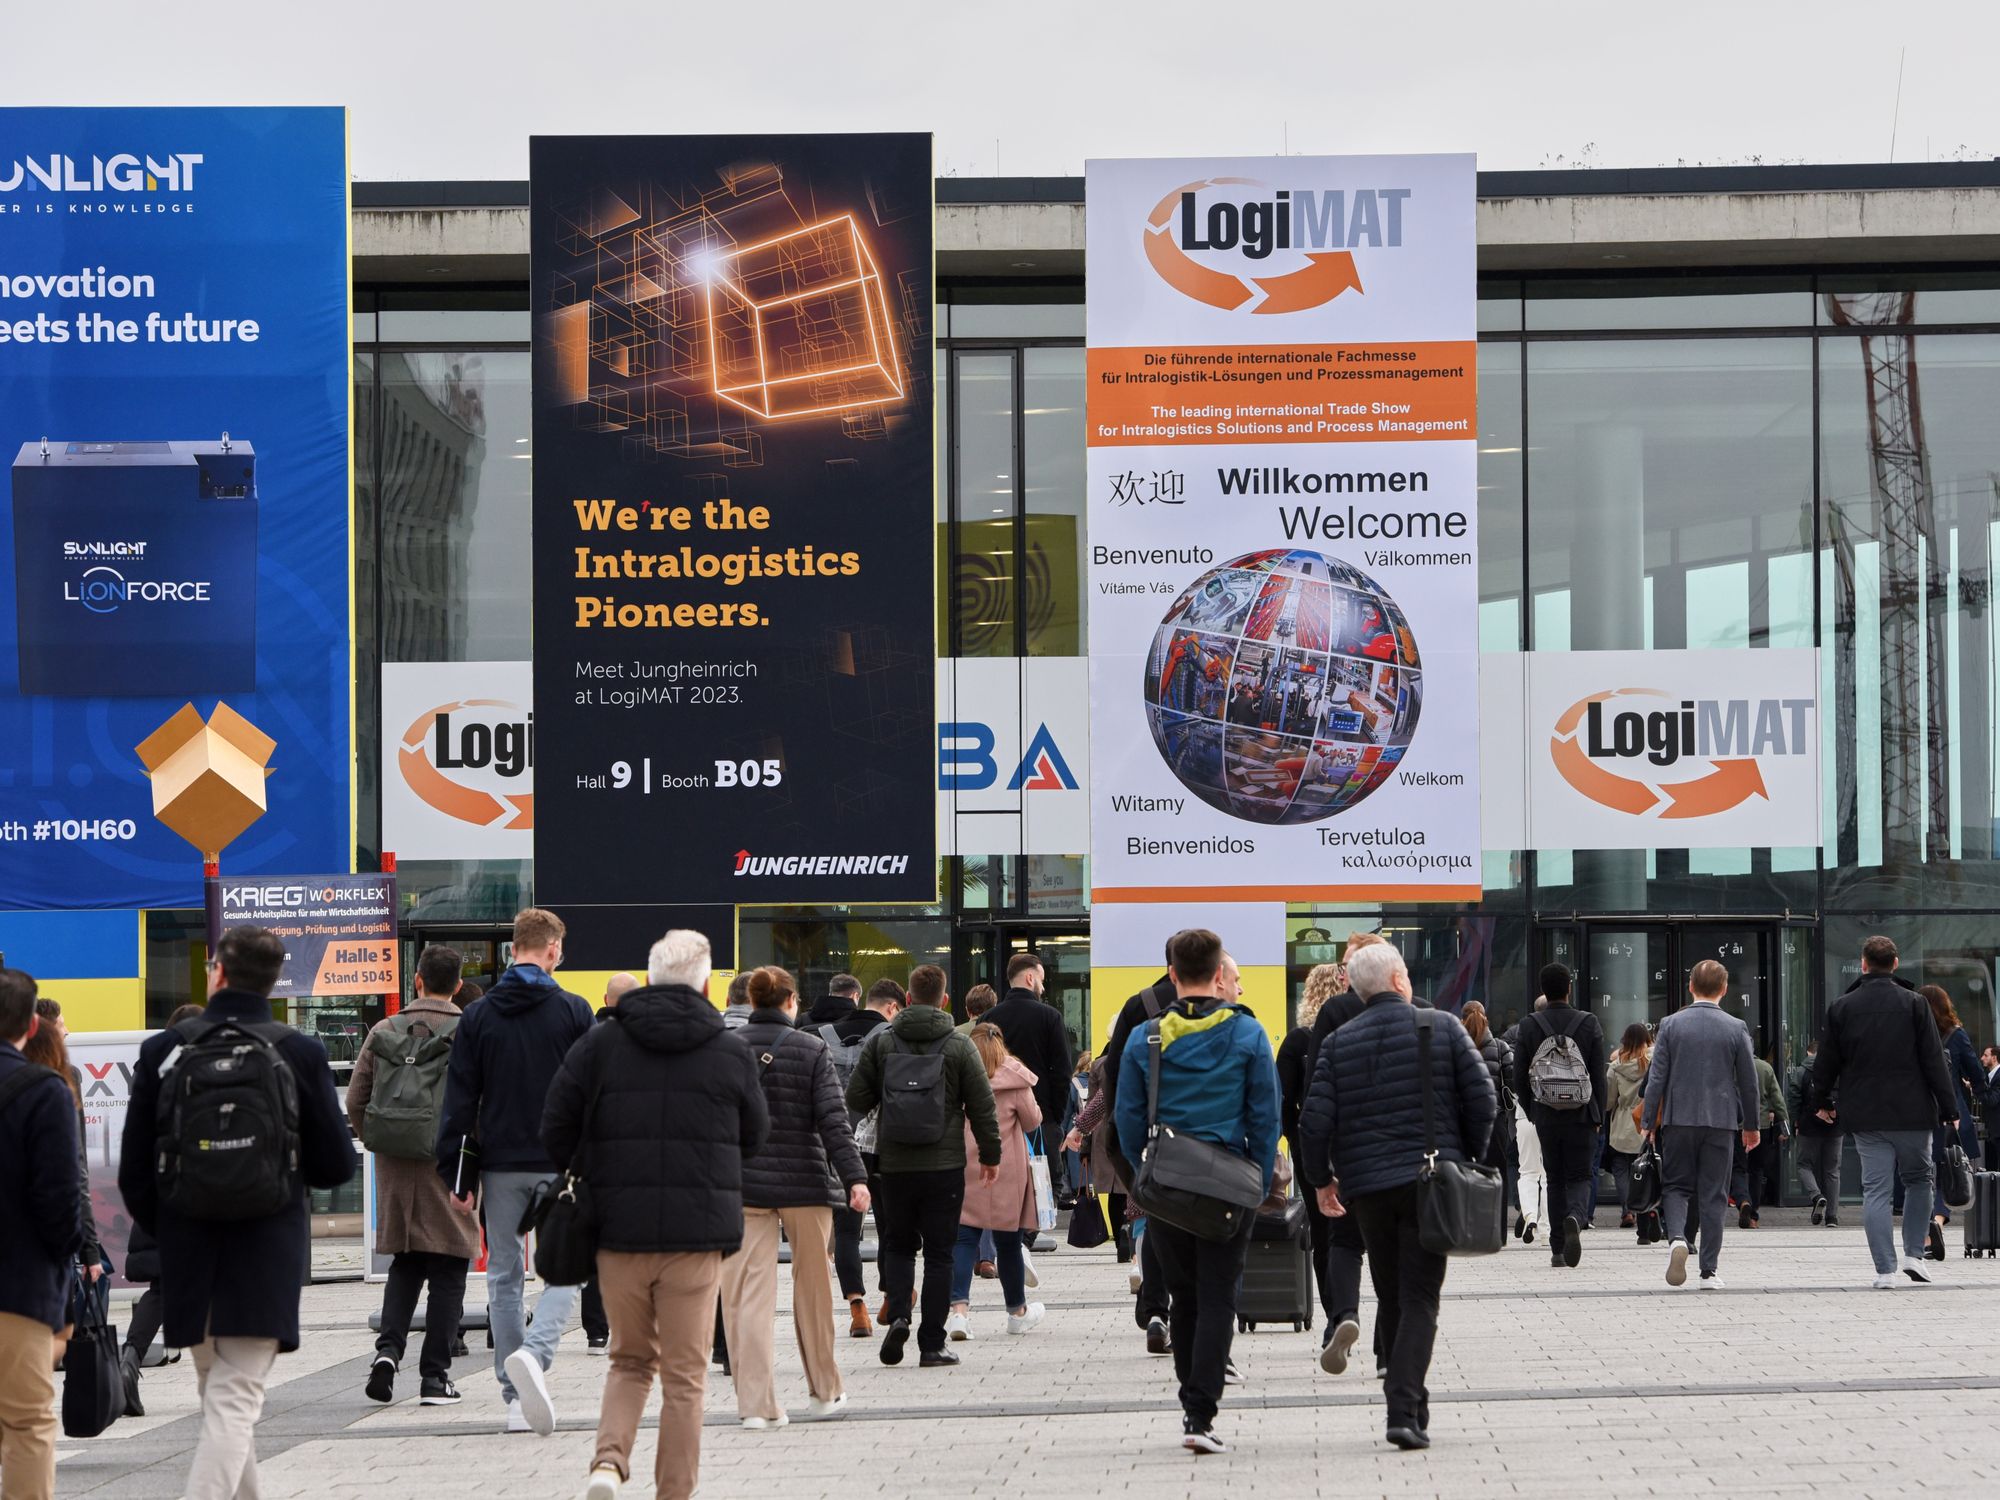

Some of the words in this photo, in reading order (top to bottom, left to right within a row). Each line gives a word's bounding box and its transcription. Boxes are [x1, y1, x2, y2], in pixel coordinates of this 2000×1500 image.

[0, 154, 203, 191] UNLIGHT
[0, 205, 20, 213] ER
[36, 204, 53, 213] IS
[70, 204, 193, 212] KNOWLEDGE
[1182, 189, 1411, 259] LogiMAT
[0, 266, 154, 298] novation
[0, 313, 69, 342] eets
[76, 313, 138, 342] the
[146, 312, 259, 342] future
[1145, 354, 1166, 365] Die
[1171, 353, 1233, 365] führende
[1238, 351, 1332, 363] internationale
[1337, 351, 1416, 362] Fachmesse
[1102, 372, 1121, 383] für
[1126, 370, 1281, 385] Intralogistik-Lösungen
[1287, 369, 1312, 380] und
[1318, 366, 1463, 381] Prozessmanagement
[1151, 406, 1176, 417] The
[1181, 405, 1231, 419] leading
[1237, 404, 1323, 416] international
[1328, 403, 1367, 414] Trade
[1372, 402, 1410, 414] Show
[1098, 425, 1118, 436] for
[1122, 423, 1212, 438] Intralogistics
[1217, 422, 1283, 434] Solutions
[1287, 421, 1313, 433] and
[1318, 421, 1373, 432] Process
[1378, 419, 1467, 433] Management
[1109, 470, 1185, 506] 欢迎
[1218, 468, 1427, 495] Willkommen
[703, 499, 770, 529] the
[1279, 506, 1466, 540] Welcome
[64, 542, 147, 554] SUNLIGHT
[1094, 546, 1213, 564] Benvenuto
[575, 545, 859, 585] Intralogistics
[1365, 551, 1471, 566] Välkommen
[1100, 583, 1145, 594] Vítáme
[1150, 582, 1174, 593] Vás
[575, 597, 769, 627] Pioneers.
[576, 662, 623, 678] Meet
[631, 660, 756, 682] Jungheinrich
[576, 689, 592, 704] at
[601, 687, 683, 708] LogiMAT
[691, 686, 742, 703] 2023.
[1588, 699, 1815, 766] LogiMAT
[436, 712, 533, 777] Log
[577, 775, 606, 788] Hall
[611, 761, 632, 788] 9
[663, 774, 708, 787] Booth
[715, 760, 781, 787] B05
[1399, 772, 1463, 785] Welkom
[1112, 795, 1184, 815] Witamy
[0, 821, 27, 840] th
[33, 819, 136, 840] #10H60
[1316, 827, 1424, 845] Tervetuloa
[1128, 836, 1254, 854] Bienvenidos
[734, 850, 908, 875] JUNGHEINRICH
[1342, 850, 1472, 872] καλωσόρισμα
[223, 887, 302, 907] KRIEG
[223, 911, 252, 919] Gesunde
[253, 910, 296, 920] Arbeitsplätze
[298, 909, 308, 917] für
[310, 909, 327, 917] mehr
[328, 907, 389, 916] Wirtschaftlichkeit
[306, 925, 338, 935] Prüfung
[340, 923, 356, 933] und
[358, 923, 390, 934] Logistik
[336, 948, 378, 963] Halle
[383, 948, 391, 962] 5
[324, 971, 358, 984] Stand
[362, 970, 392, 982] 5D45
